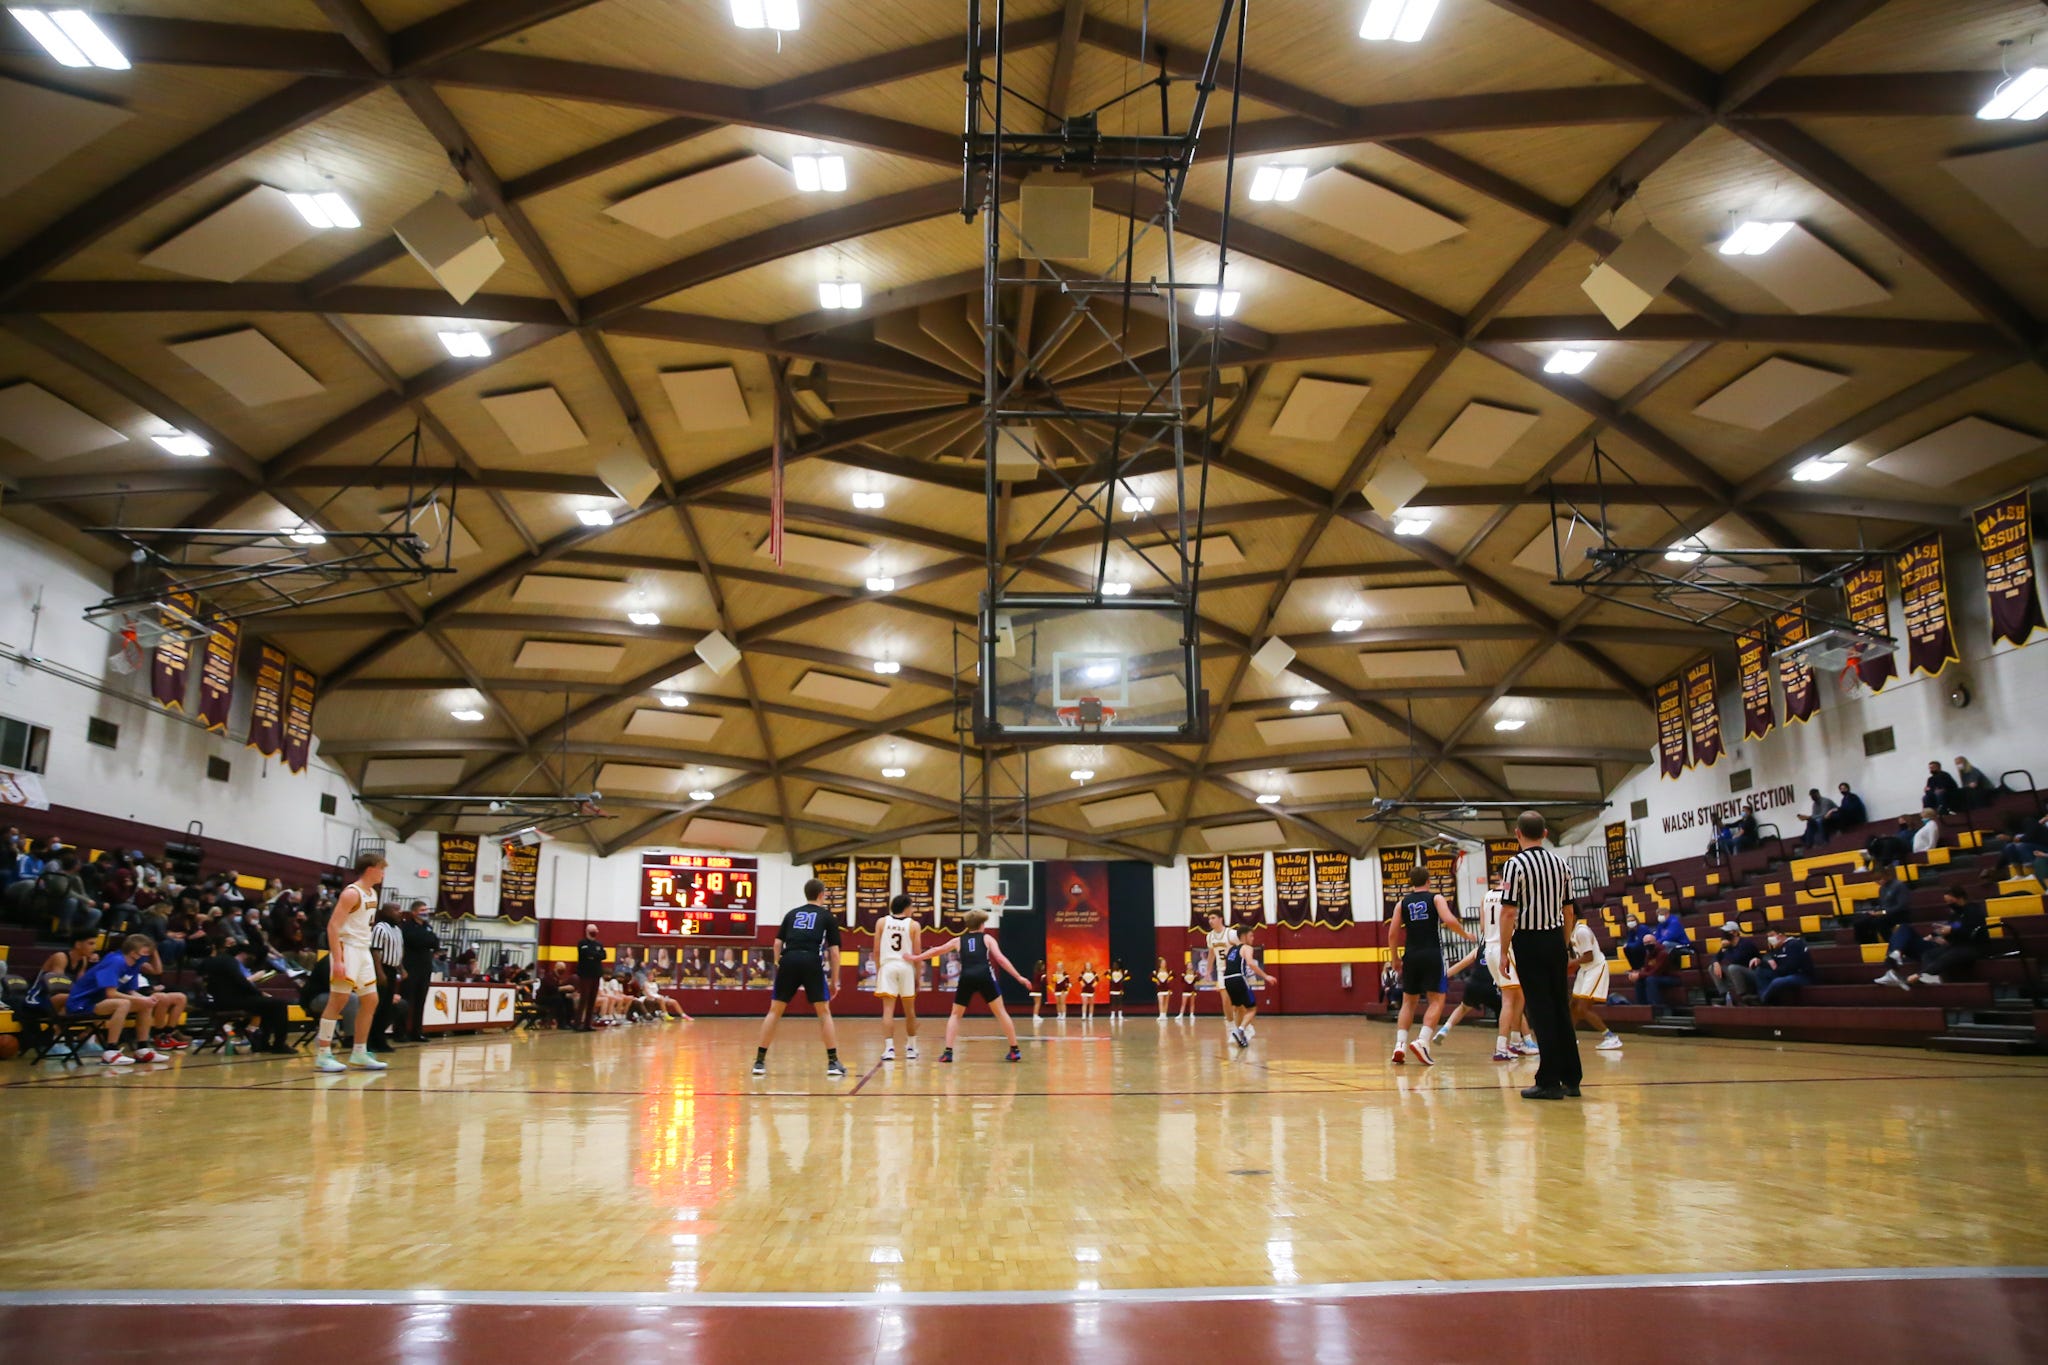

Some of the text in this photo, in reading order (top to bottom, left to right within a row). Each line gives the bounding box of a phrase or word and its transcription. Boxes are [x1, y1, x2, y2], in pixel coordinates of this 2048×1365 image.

[1977, 505, 2026, 535] WALSH
[1981, 522, 2027, 551] JESUIT
[1897, 544, 1938, 572] WALSH
[1901, 560, 1940, 588] JESUIT
[1662, 784, 1796, 834] WALSH STUDENT SECTION
[1190, 860, 1222, 870] WALSH
[1230, 857, 1262, 868] WALSH
[1275, 855, 1308, 865] WALSH
[1315, 853, 1348, 863] WALSH
[1192, 872, 1222, 881] JESUIT
[1231, 869, 1262, 879] JESUIT
[1277, 866, 1309, 876] JESUIT
[1317, 865, 1349, 875] JESUIT
[650, 877, 673, 896] 37
[793, 911, 817, 930] 21
[1407, 901, 1430, 921] 12
[1490, 905, 1496, 925] 1
[891, 933, 903, 952] 3
[1218, 949, 1226, 960] 5
